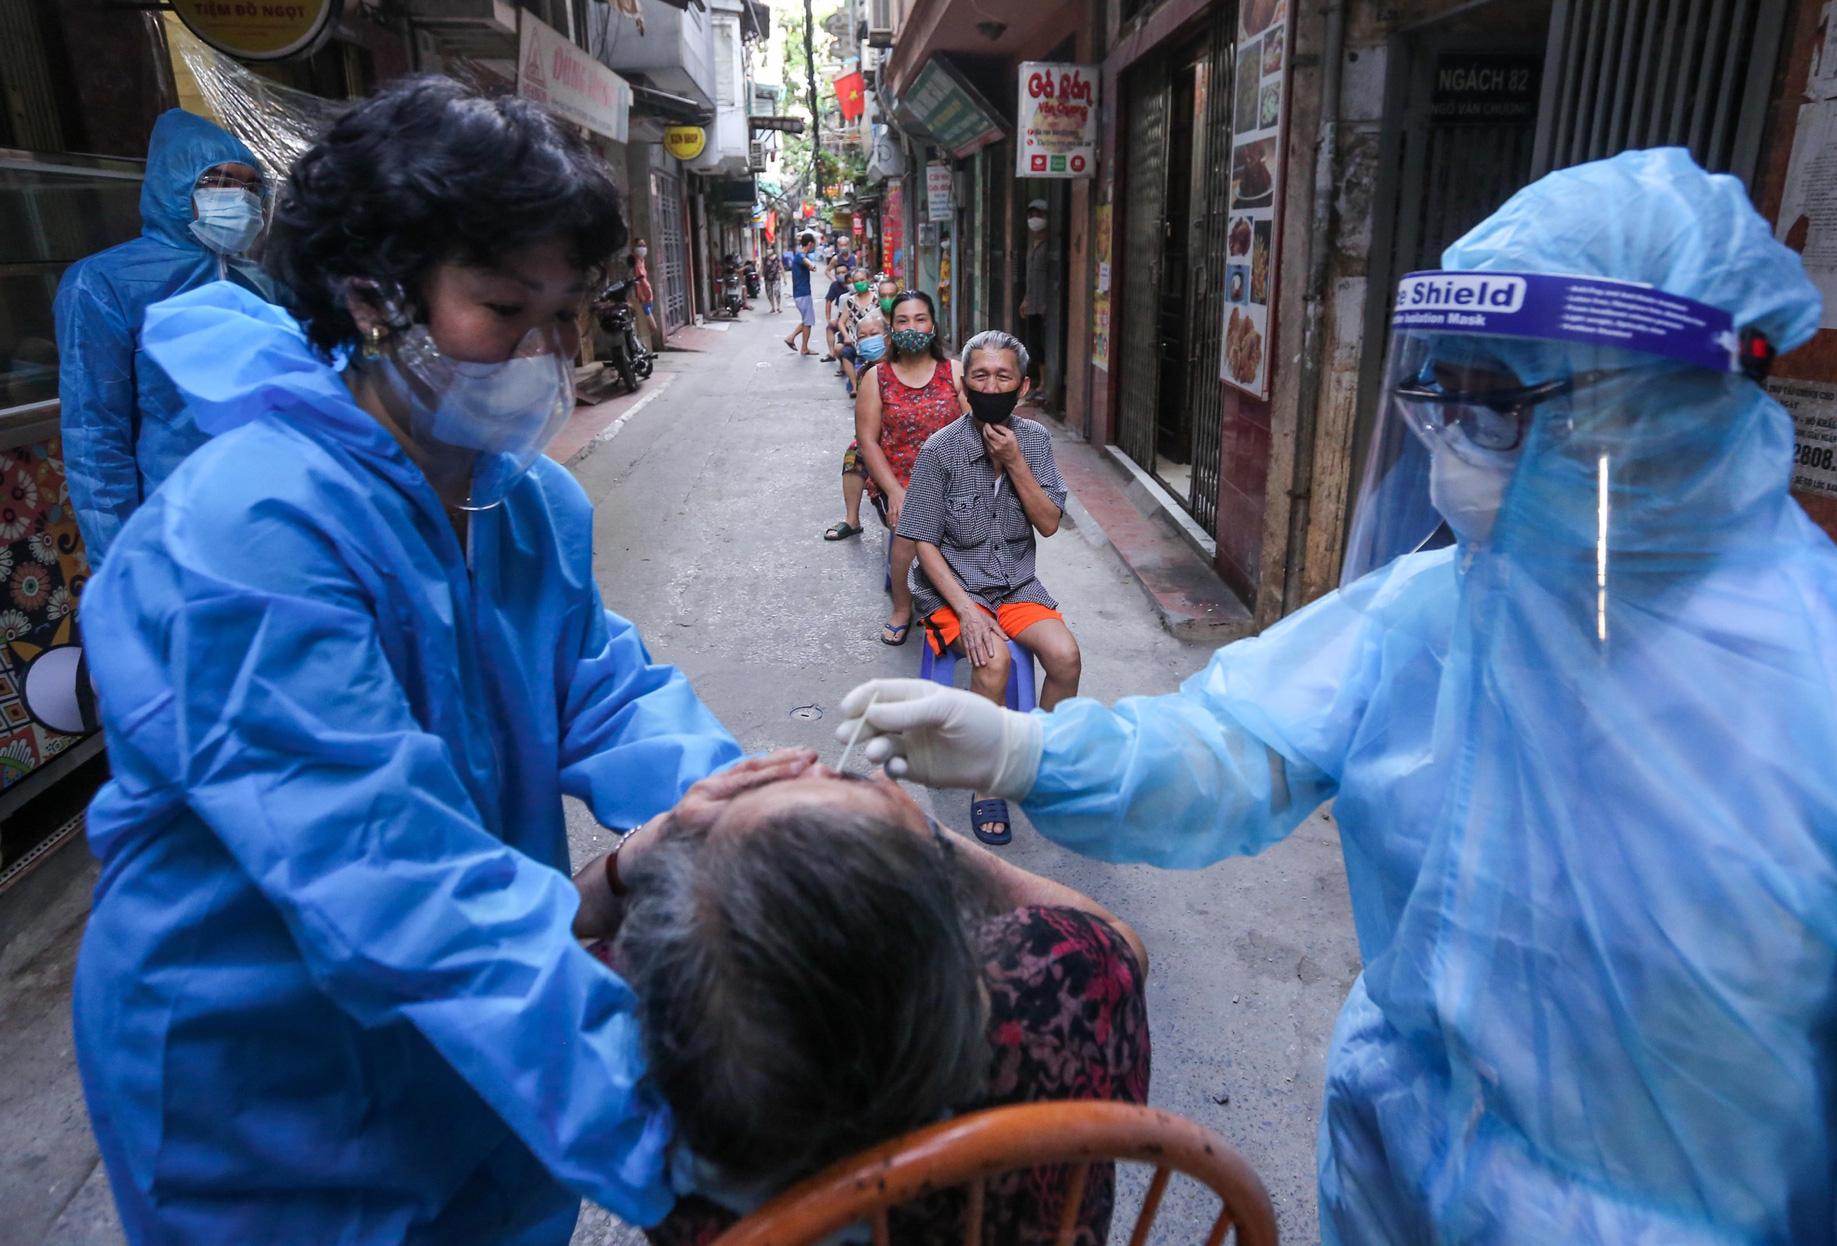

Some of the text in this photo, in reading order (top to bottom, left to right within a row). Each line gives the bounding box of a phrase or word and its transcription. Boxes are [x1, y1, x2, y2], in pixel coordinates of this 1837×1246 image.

[194, 1, 305, 21] TIỆM ĐỒ NGỌT
[1439, 62, 1529, 92] NGÁCH 82
[1412, 282, 1515, 307] Shield
[1448, 312, 1486, 326] Mask
